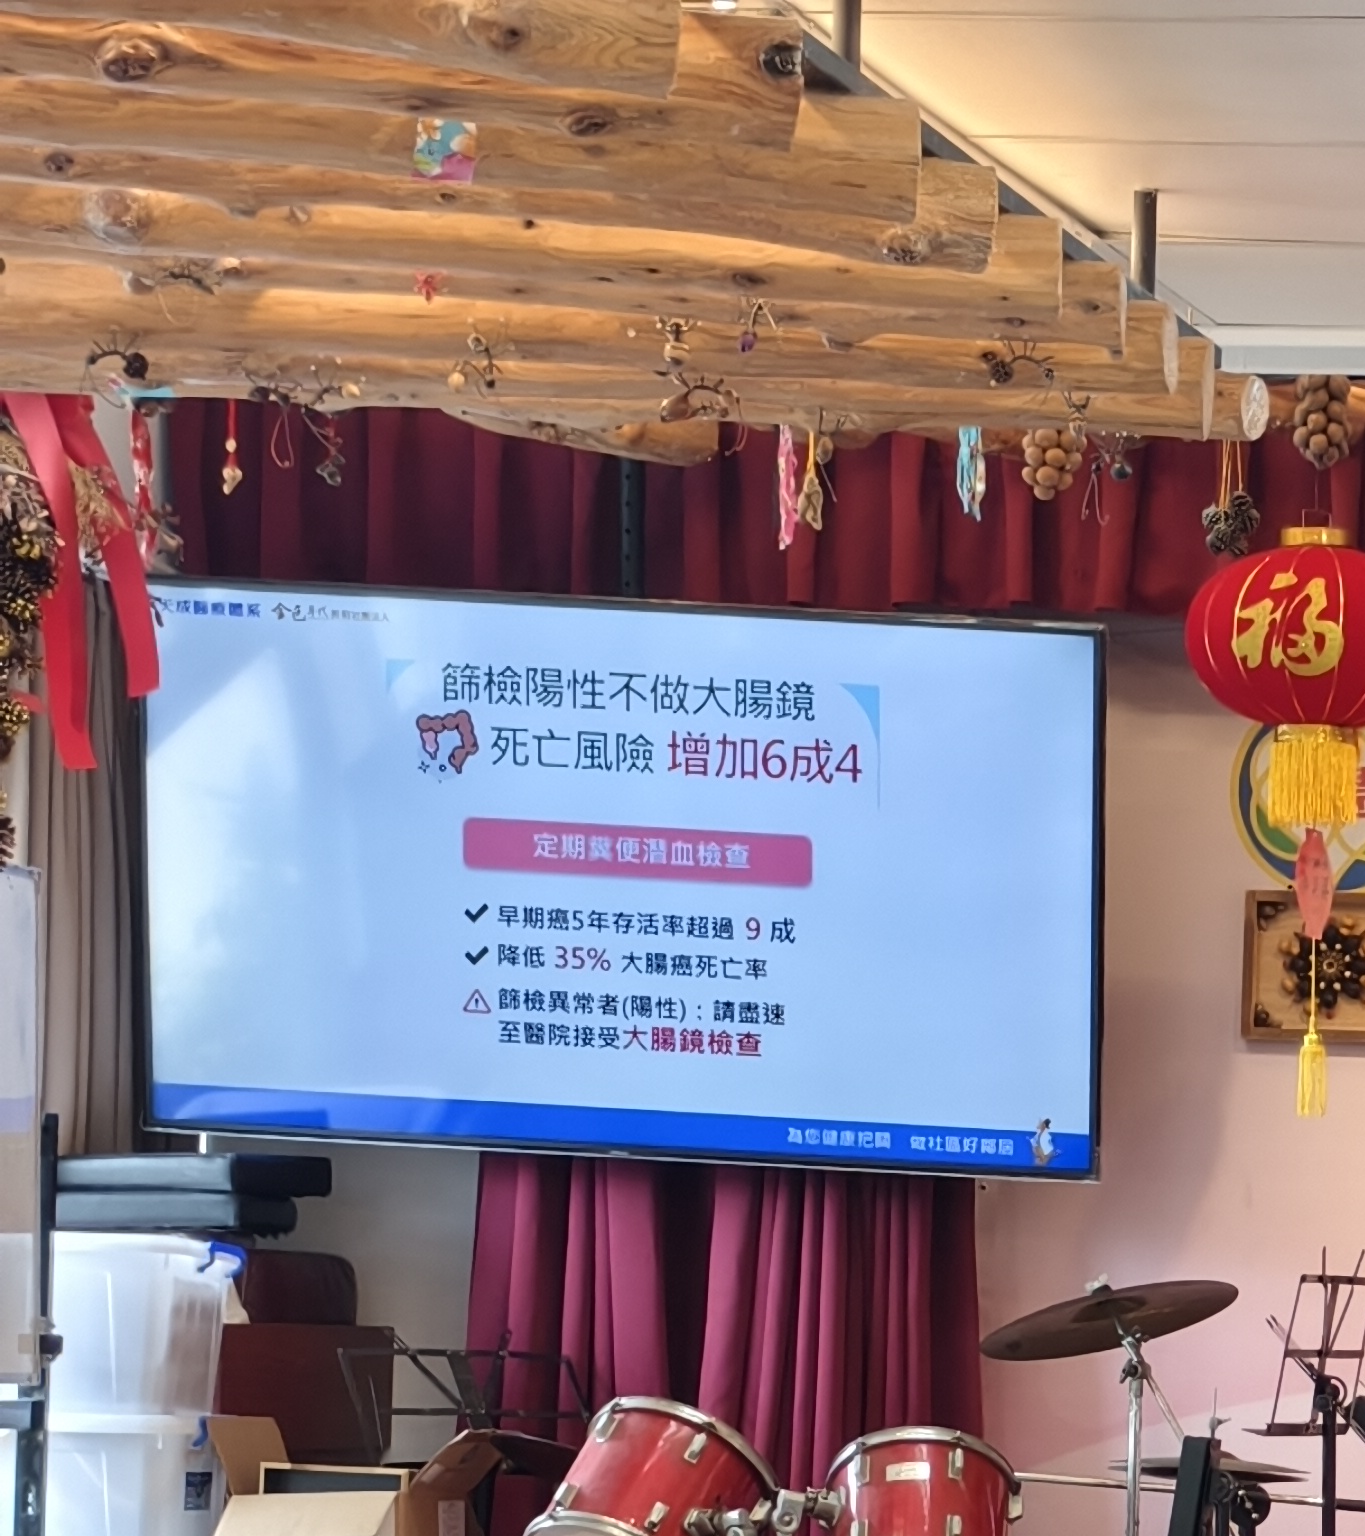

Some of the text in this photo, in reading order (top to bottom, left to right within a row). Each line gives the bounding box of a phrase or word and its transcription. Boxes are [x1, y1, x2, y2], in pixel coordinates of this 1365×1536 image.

[1231, 572, 1344, 677] 福
[442, 662, 816, 722] 篩檢陽性不做大腸鏡
[490, 725, 863, 784] 死亡風險 增加6成4
[744, 917, 762, 941] 9
[770, 917, 796, 944] 成
[496, 944, 768, 981] 降低 35% 大腸癌死亡率
[498, 1020, 762, 1057] 至醫院接受大腸鏡檢查
